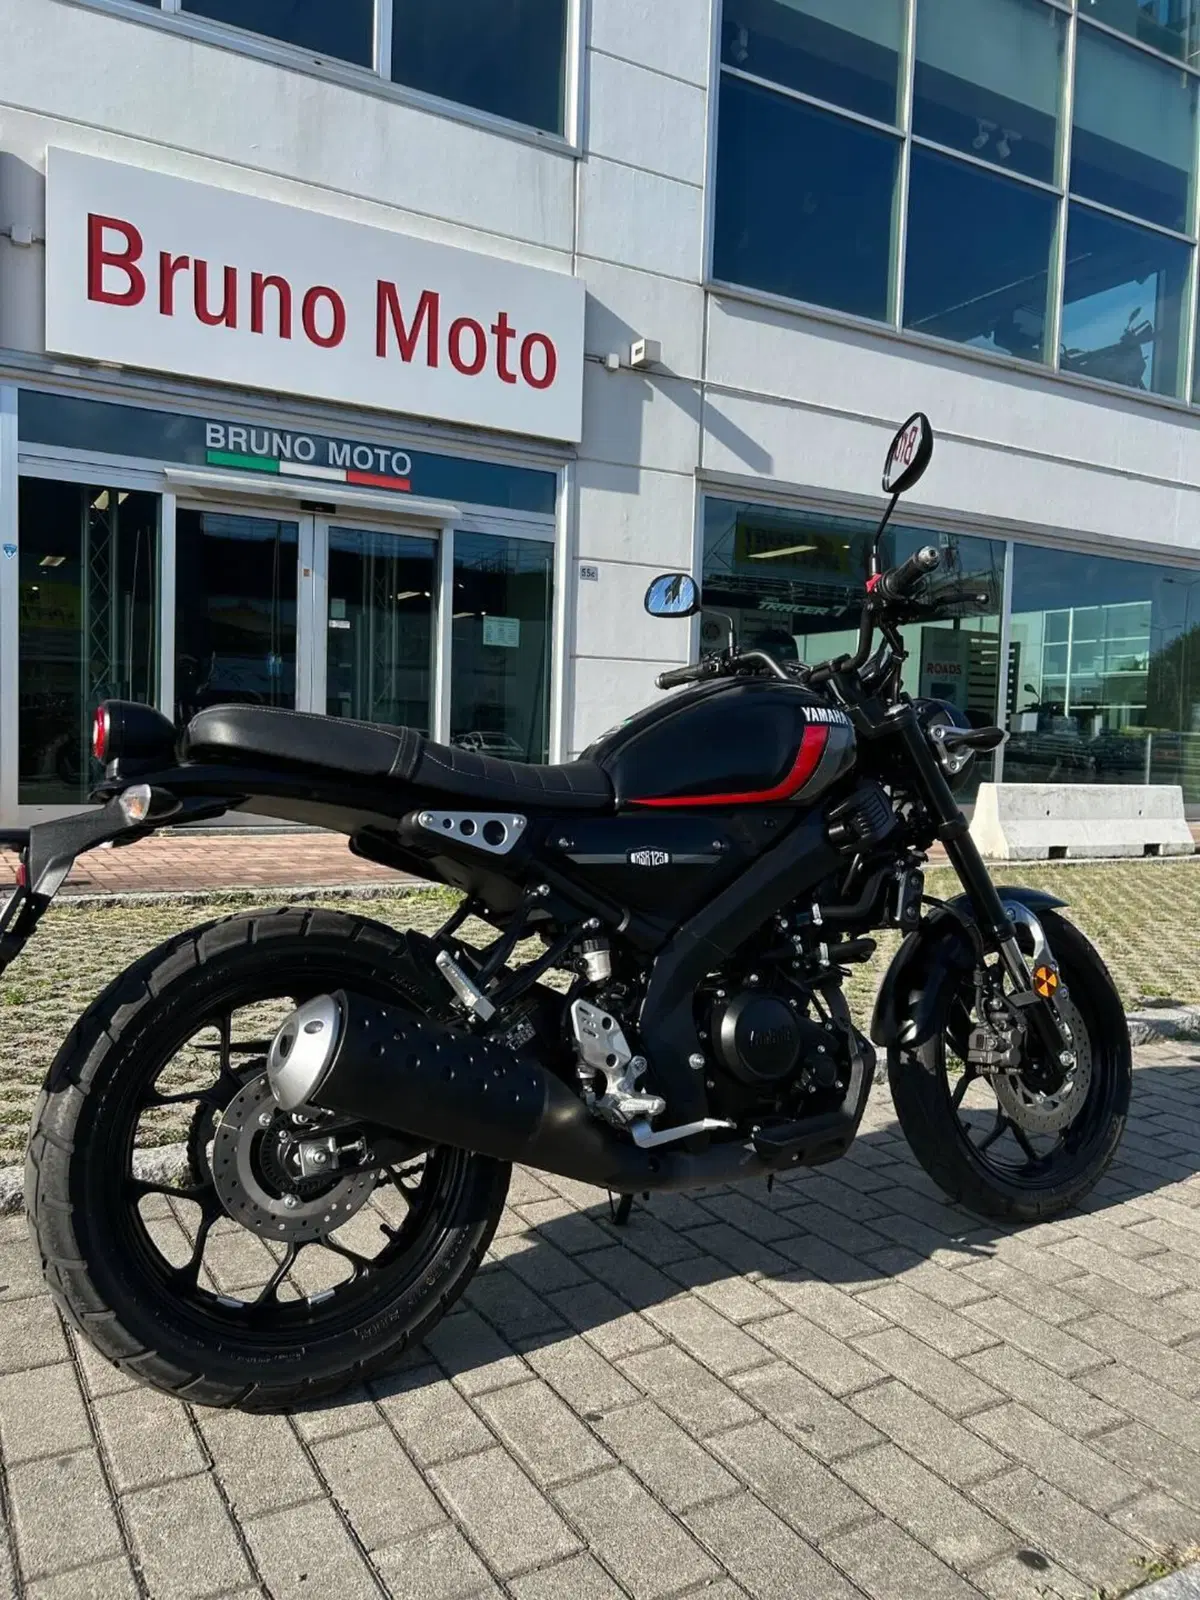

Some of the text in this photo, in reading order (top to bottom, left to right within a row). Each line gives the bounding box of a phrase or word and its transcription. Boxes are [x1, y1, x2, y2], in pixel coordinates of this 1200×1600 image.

[88, 213, 558, 389] Bruno Moto
[206, 422, 413, 475] BRUNO MOTO
[757, 601, 847, 617] TRACER 7
[927, 663, 962, 675] ROADS
[801, 706, 849, 725] YAMAHA
